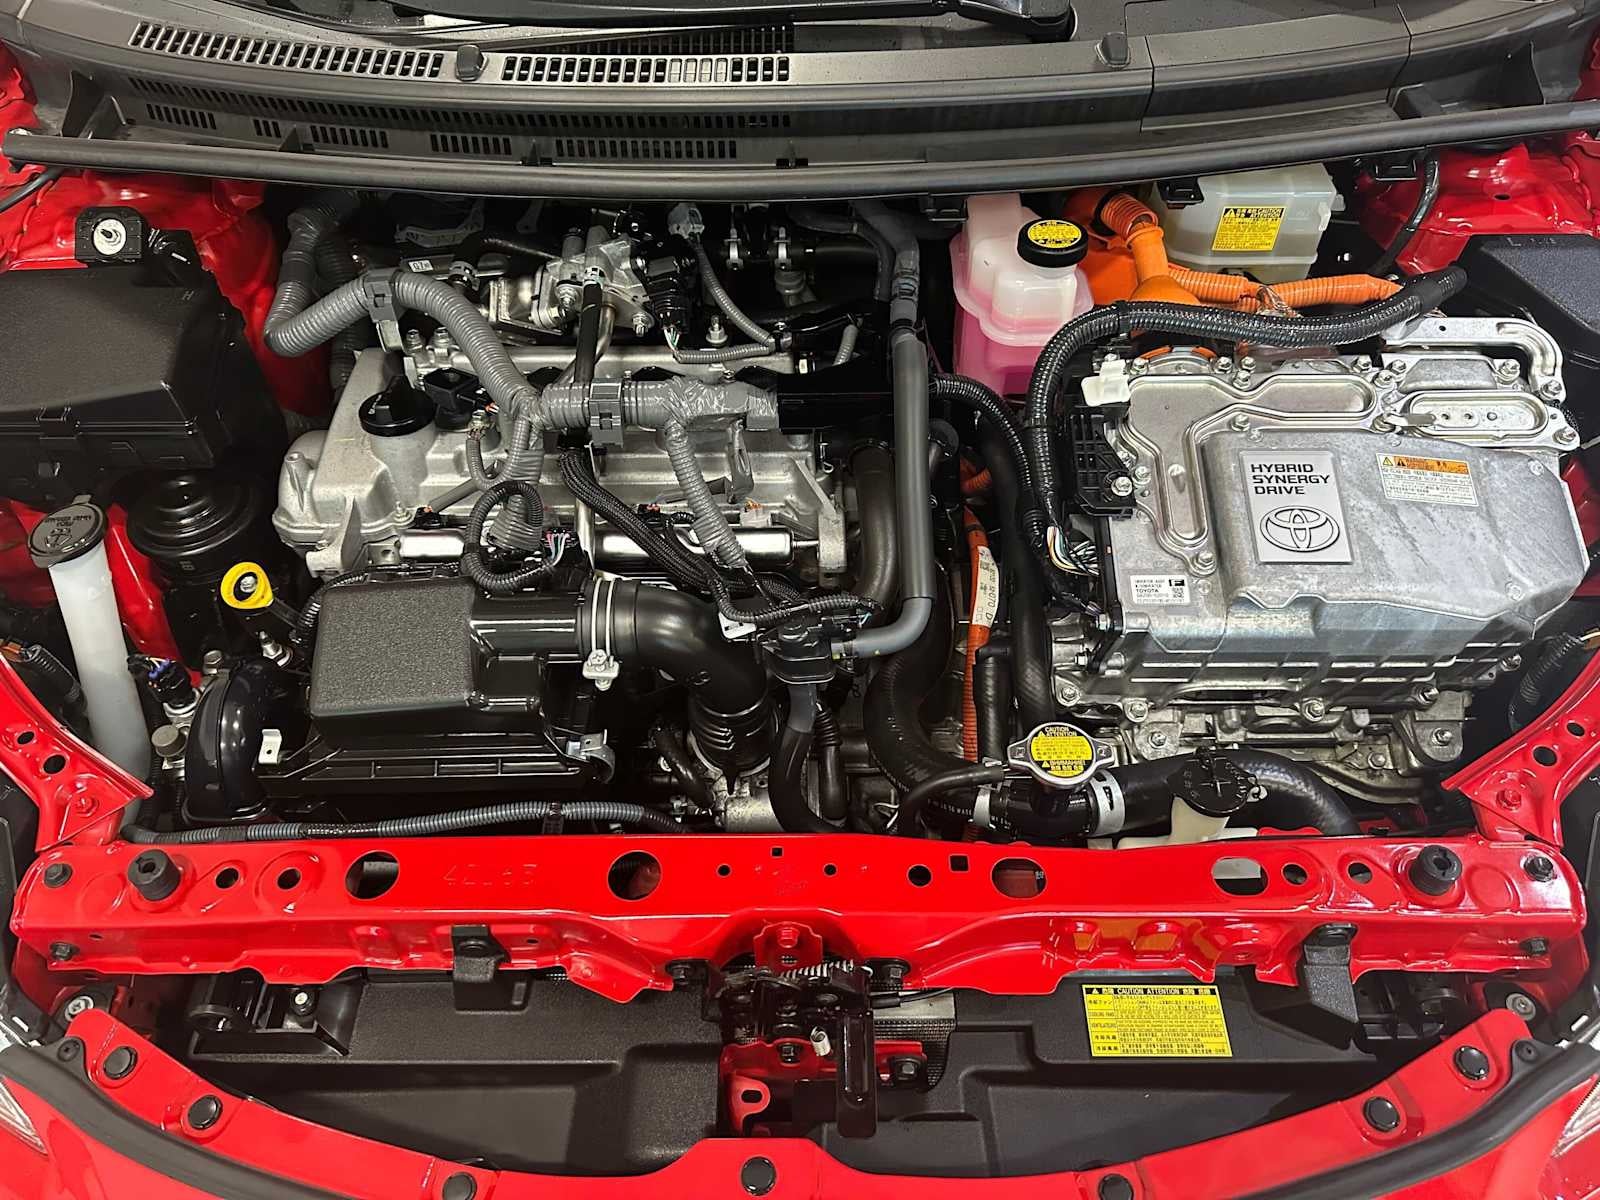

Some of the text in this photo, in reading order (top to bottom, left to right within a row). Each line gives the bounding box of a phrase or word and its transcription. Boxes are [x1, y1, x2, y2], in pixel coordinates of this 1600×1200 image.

[1251, 464, 1314, 473] HYBRID
[1252, 475, 1330, 484] SYNERGY
[1254, 486, 1305, 495] DRIVE
